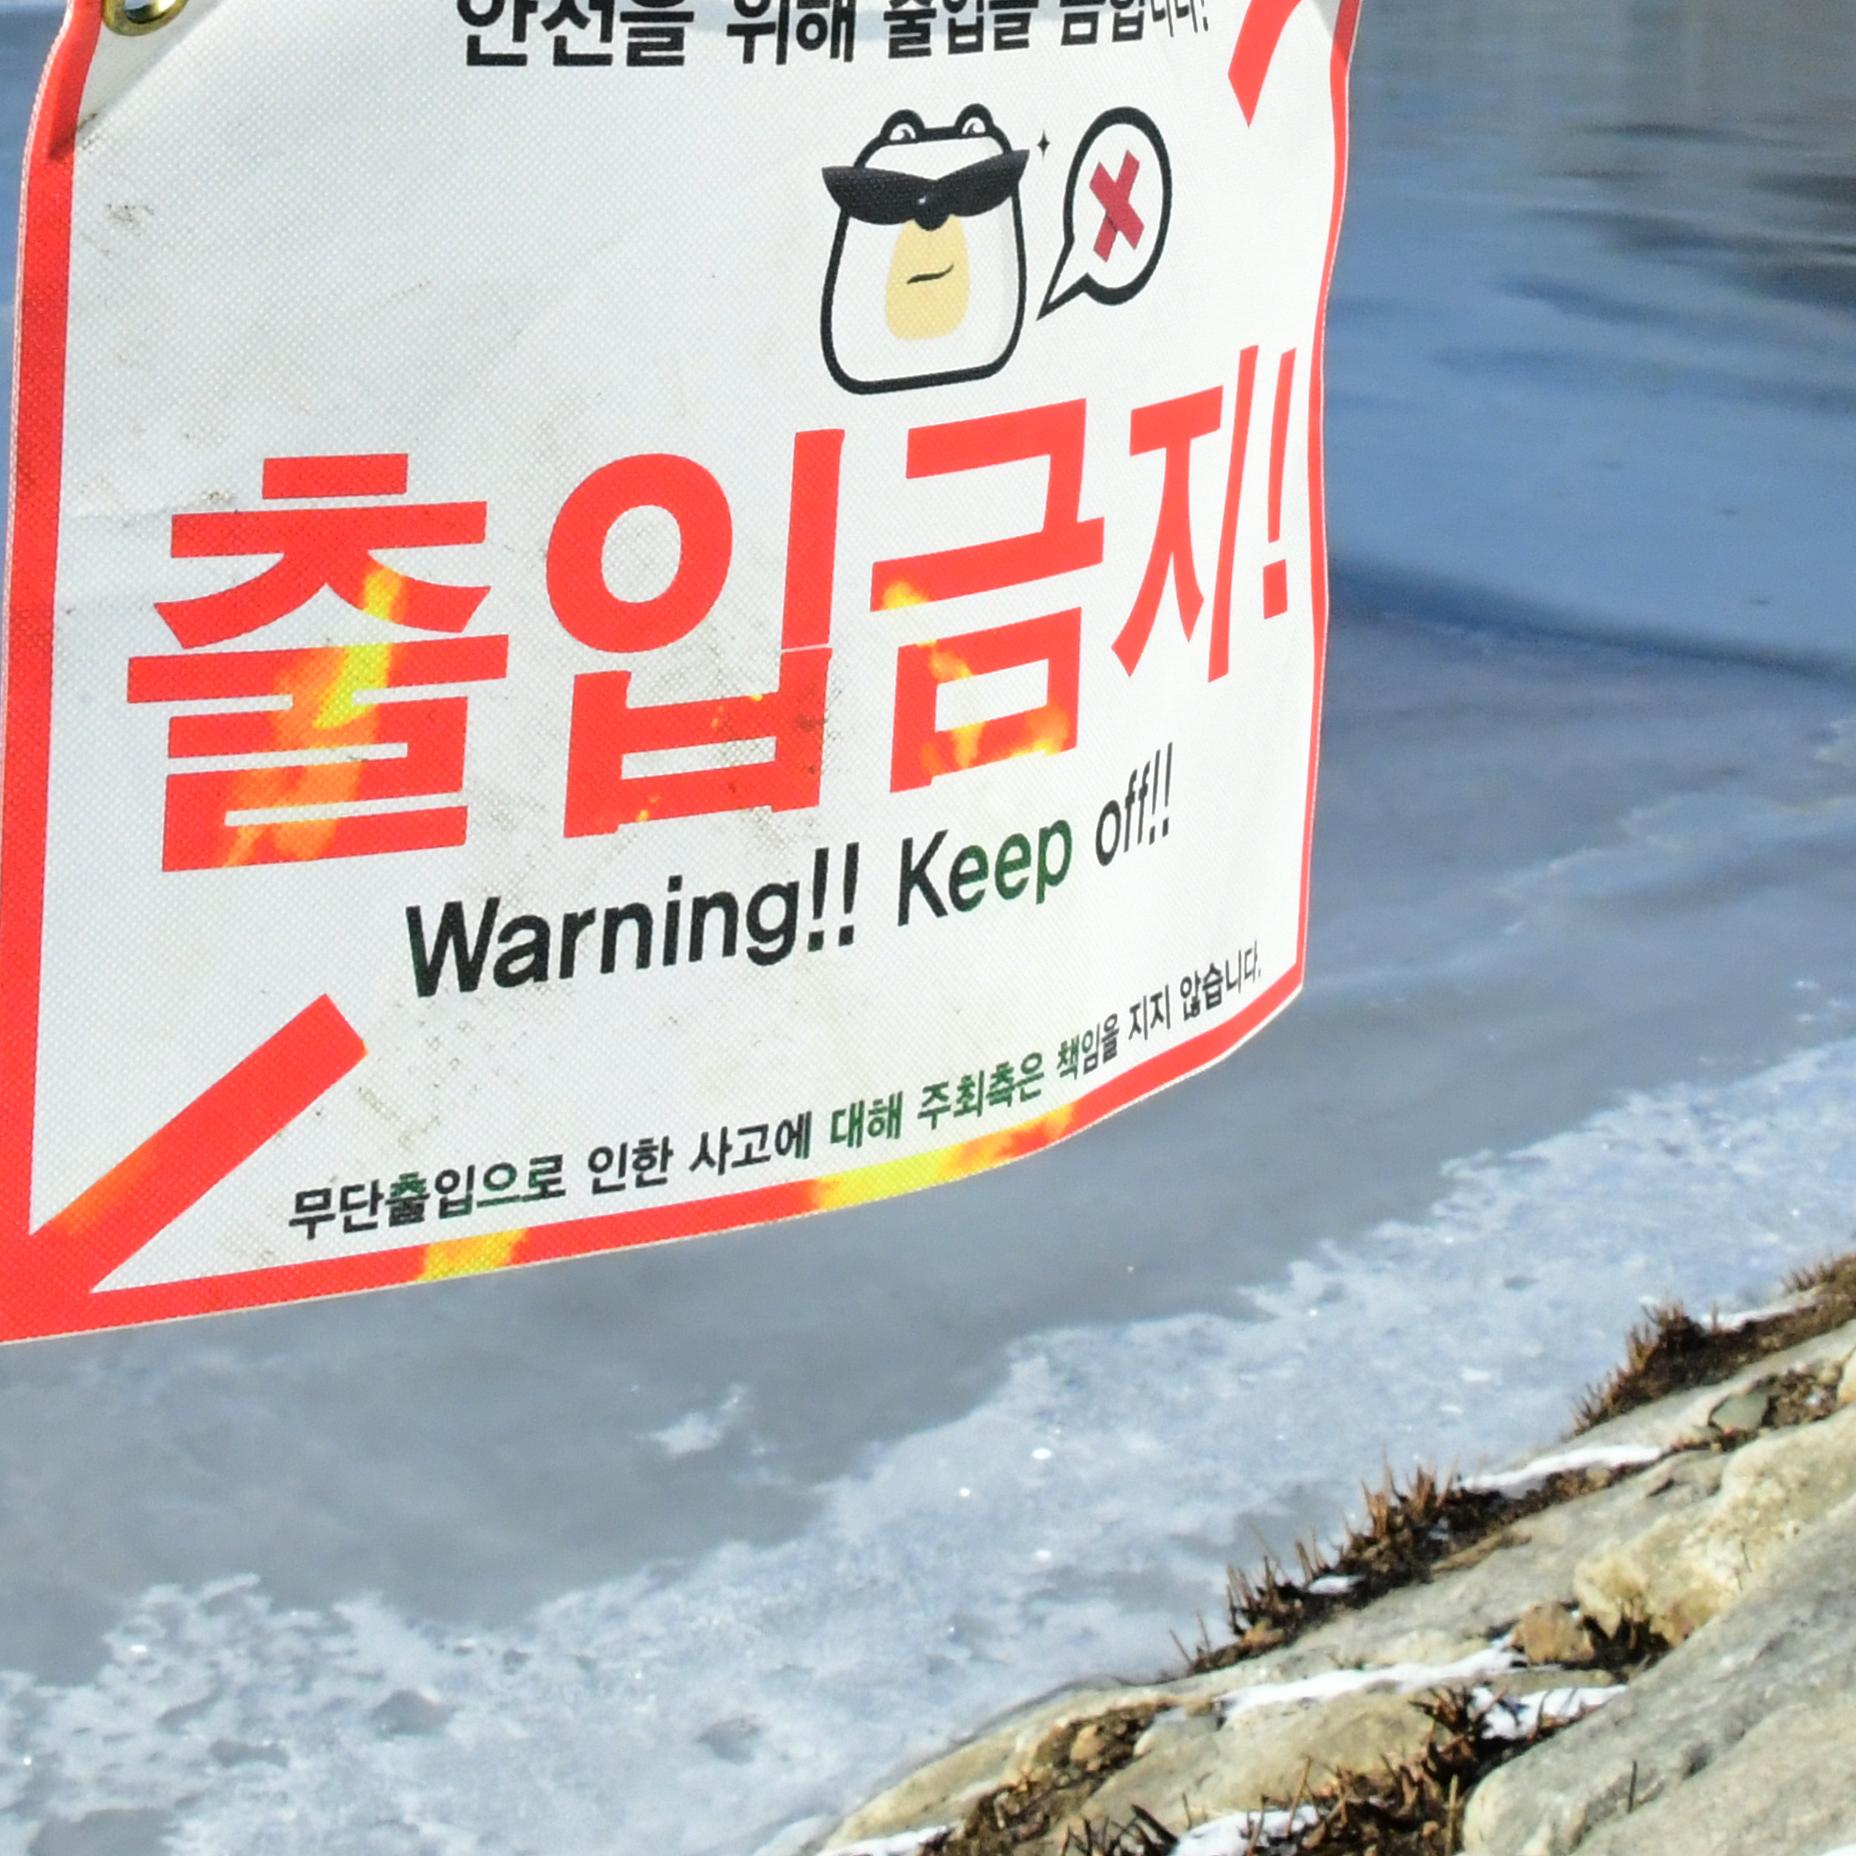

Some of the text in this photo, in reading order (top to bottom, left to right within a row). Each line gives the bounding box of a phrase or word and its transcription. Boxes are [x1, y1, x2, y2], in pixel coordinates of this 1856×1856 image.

[127, 344, 1297, 872] 출입금지!
[405, 741, 1173, 999] Warning!! Keep off!!
[288, 1153, 568, 1240] 무단출입으로
[587, 1135, 674, 1195] 인한
[689, 1110, 813, 1175] 사고에
[830, 1091, 903, 1148] 대해
[1056, 1012, 1120, 1080] 책임을
[1128, 984, 1171, 1041] 지지
[1179, 938, 1262, 1021] 않습니다.
